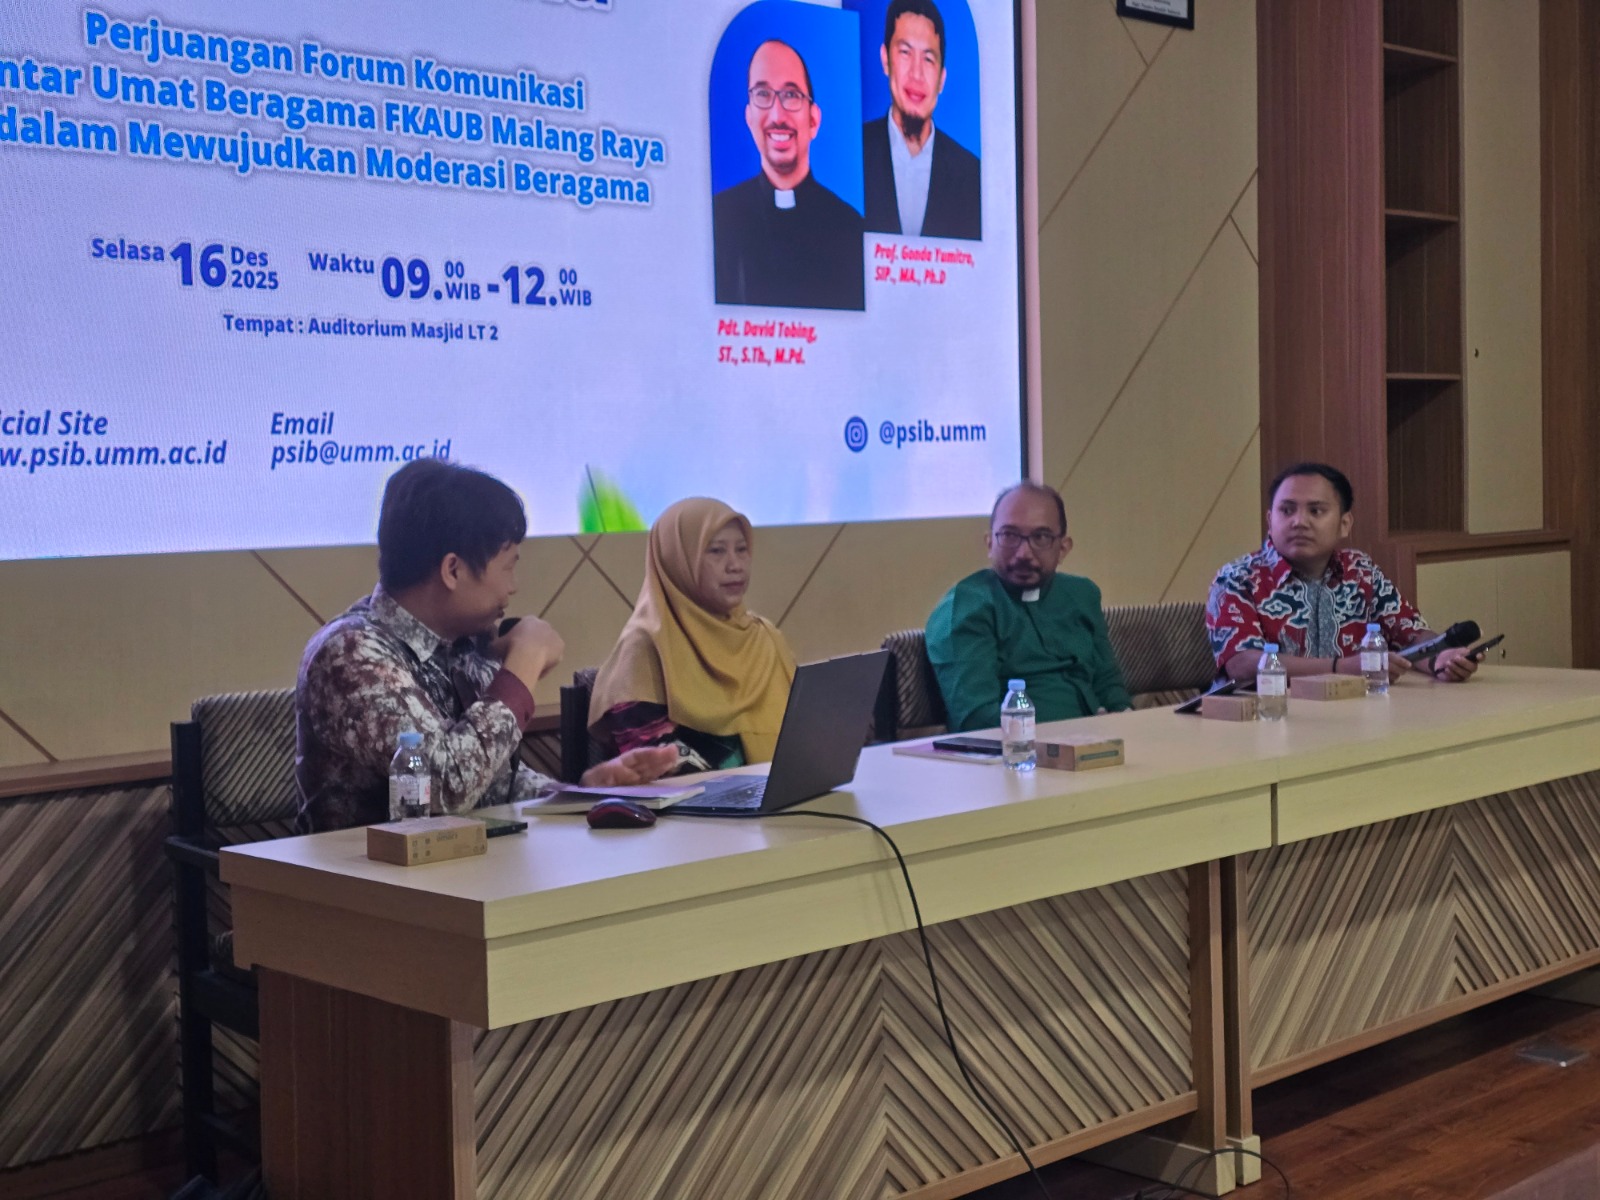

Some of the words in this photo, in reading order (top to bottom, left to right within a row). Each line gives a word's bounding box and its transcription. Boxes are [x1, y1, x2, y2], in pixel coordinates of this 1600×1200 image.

[86, 11, 293, 74] Perjuangan
[302, 43, 406, 86] Forum
[412, 59, 584, 110] Komunikasi
[92, 65, 196, 109] Umat
[205, 79, 376, 129] Beragama
[385, 102, 483, 142] FKAUB
[492, 115, 595, 162] Malang
[601, 129, 664, 168] Raya
[0, 105, 118, 152] dalam
[128, 119, 357, 175] Mewujudkan
[366, 146, 505, 189] Moderasi
[514, 161, 650, 206] Beragama
[91, 237, 165, 262] Selasa
[169, 242, 227, 288] 16
[230, 246, 269, 268] Des
[308, 252, 375, 274] Waktu
[444, 260, 465, 280] 00
[874, 243, 898, 264] Prof.
[231, 269, 279, 290] 2025
[445, 281, 481, 301] WIB
[559, 268, 578, 286] 00
[923, 268, 946, 285] Ph.D
[559, 288, 592, 307] WIB
[308, 317, 407, 338] Auditorium
[411, 322, 464, 344] Masjid
[468, 324, 486, 340] LT
[489, 325, 499, 341] 2
[717, 318, 741, 337] Pdt.
[743, 320, 776, 338] David
[778, 321, 817, 344] Tobing,
[0, 409, 51, 436] cial
[57, 410, 109, 436] Site
[270, 411, 335, 435] Email
[879, 419, 986, 448] @psib.umm
[270, 438, 452, 470] psib@umm.acid
